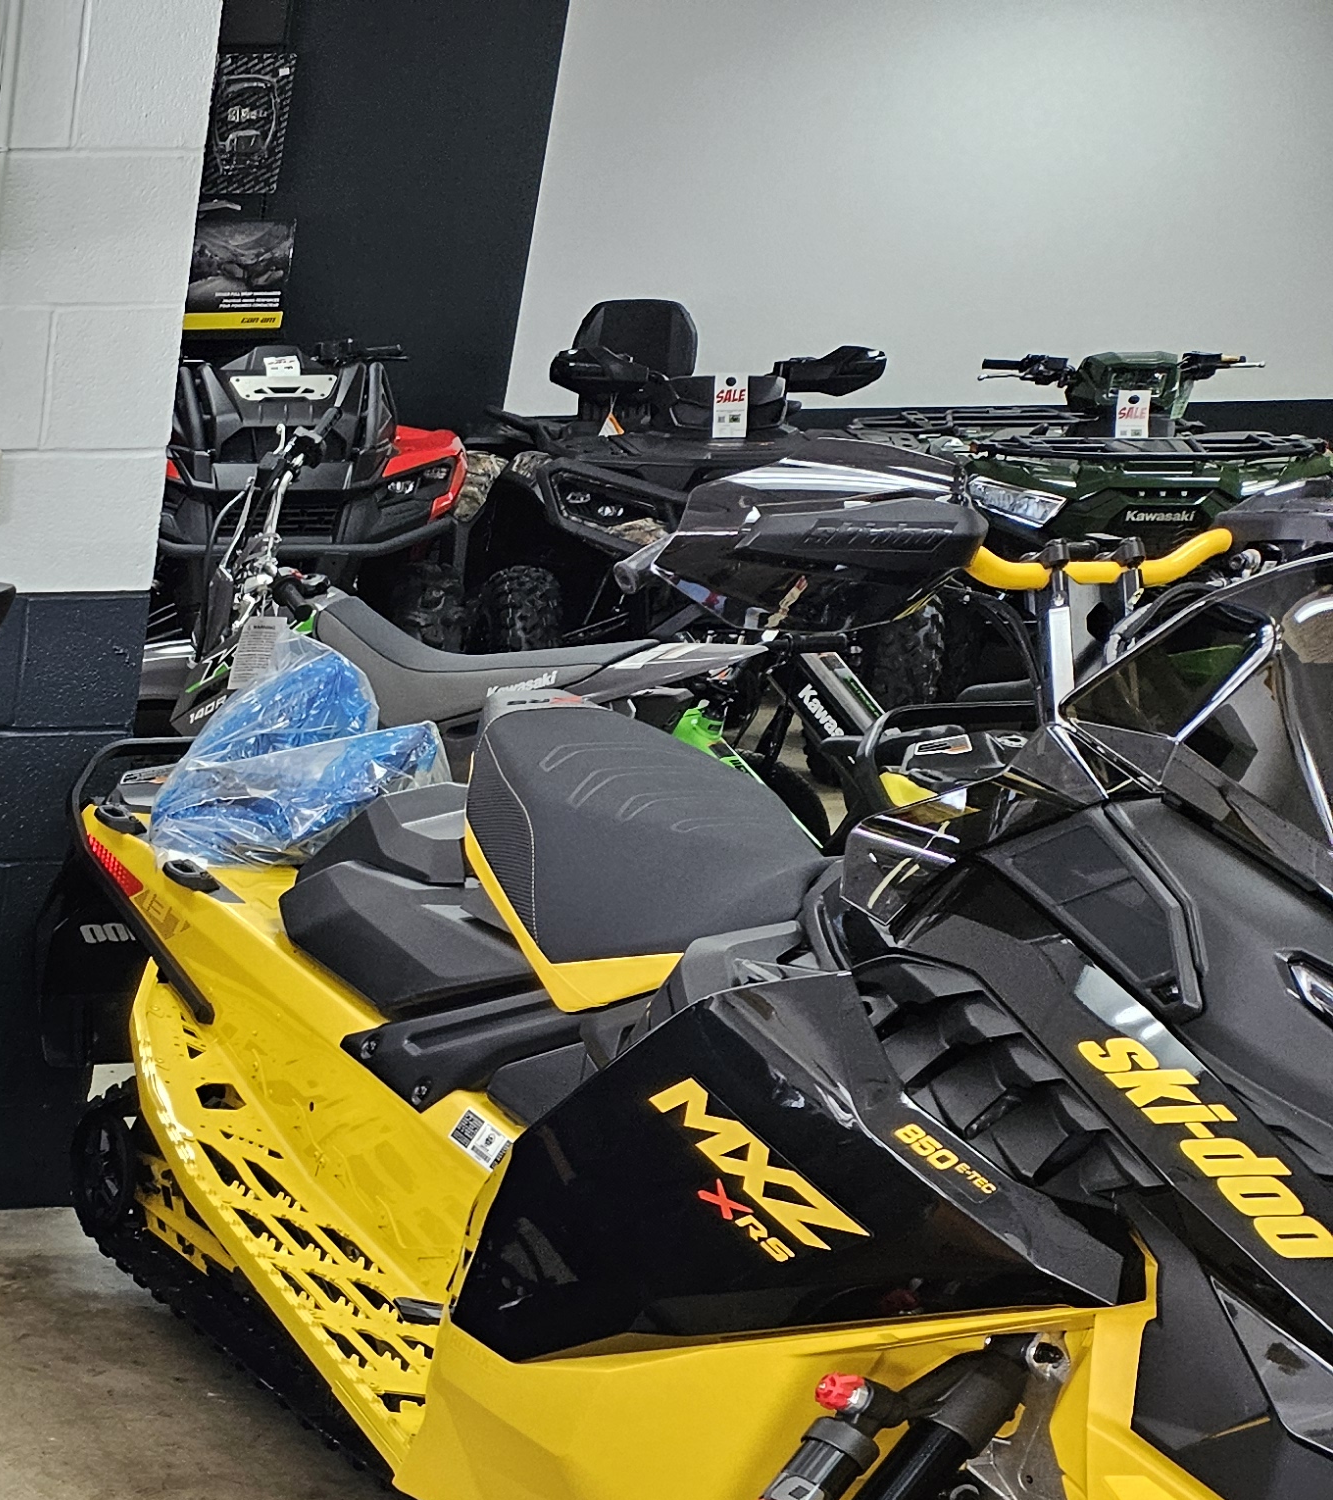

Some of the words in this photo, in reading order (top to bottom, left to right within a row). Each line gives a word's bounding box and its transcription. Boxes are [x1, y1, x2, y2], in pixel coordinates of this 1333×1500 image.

[715, 388, 747, 404] SALE
[1118, 406, 1147, 420] SALE
[1125, 510, 1195, 522] Kawasaki
[648, 1077, 871, 1250] MXZ
[894, 1123, 960, 1170] 850
[954, 1162, 998, 1194] E-TEC
[1077, 1037, 1333, 1259] ski-doo
